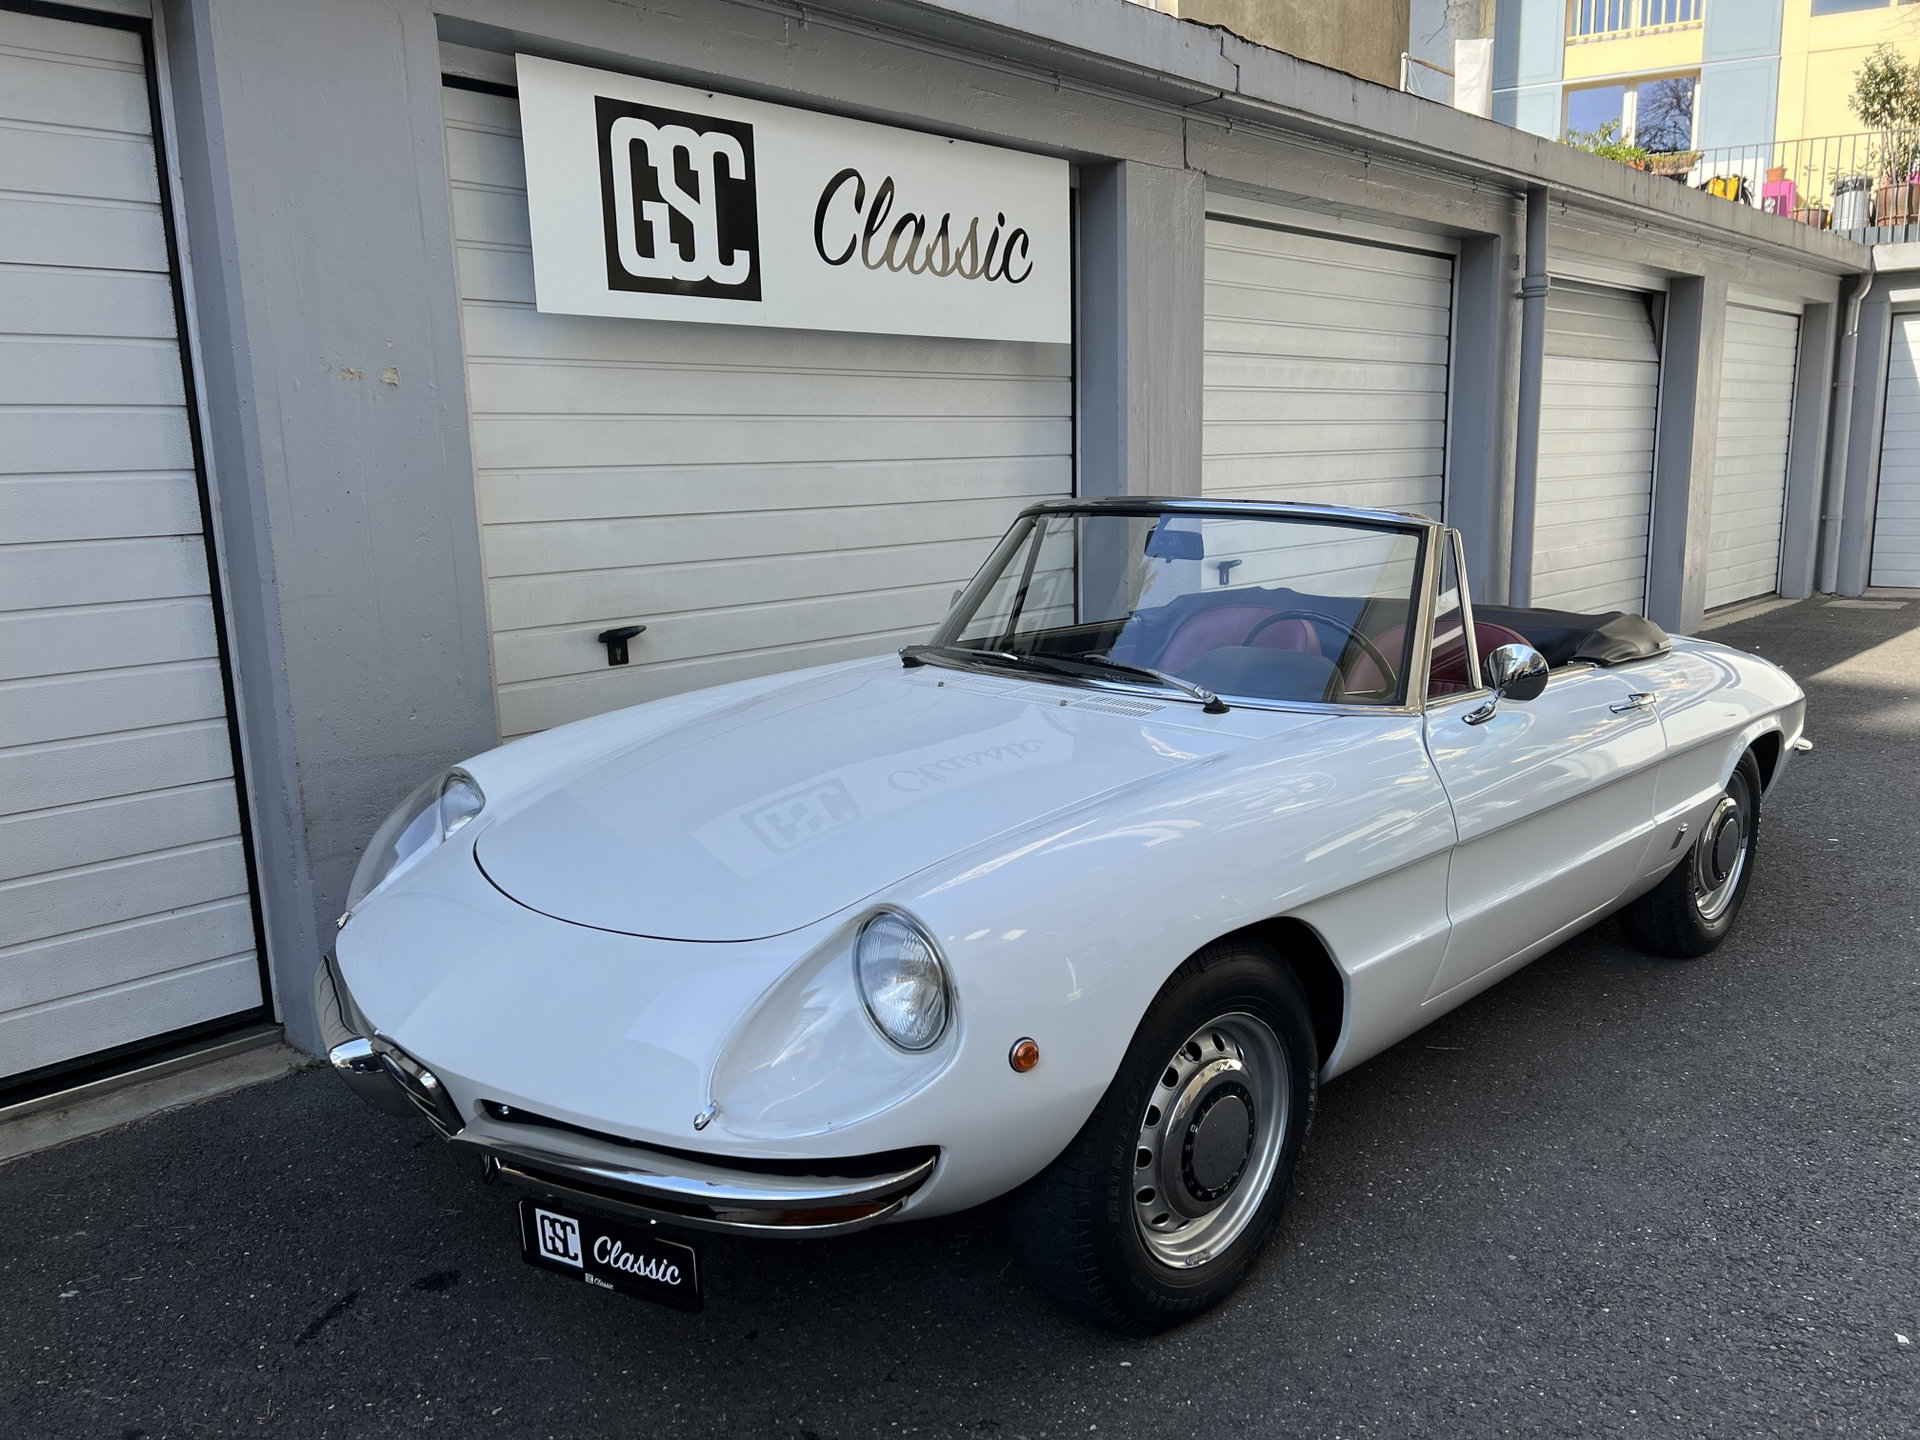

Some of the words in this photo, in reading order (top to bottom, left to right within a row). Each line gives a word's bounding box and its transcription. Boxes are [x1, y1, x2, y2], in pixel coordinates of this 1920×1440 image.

[610, 116, 750, 286] GSC
[813, 167, 1034, 285] Classic
[540, 1214, 579, 1261] GSC
[593, 1235, 682, 1285] Classic
